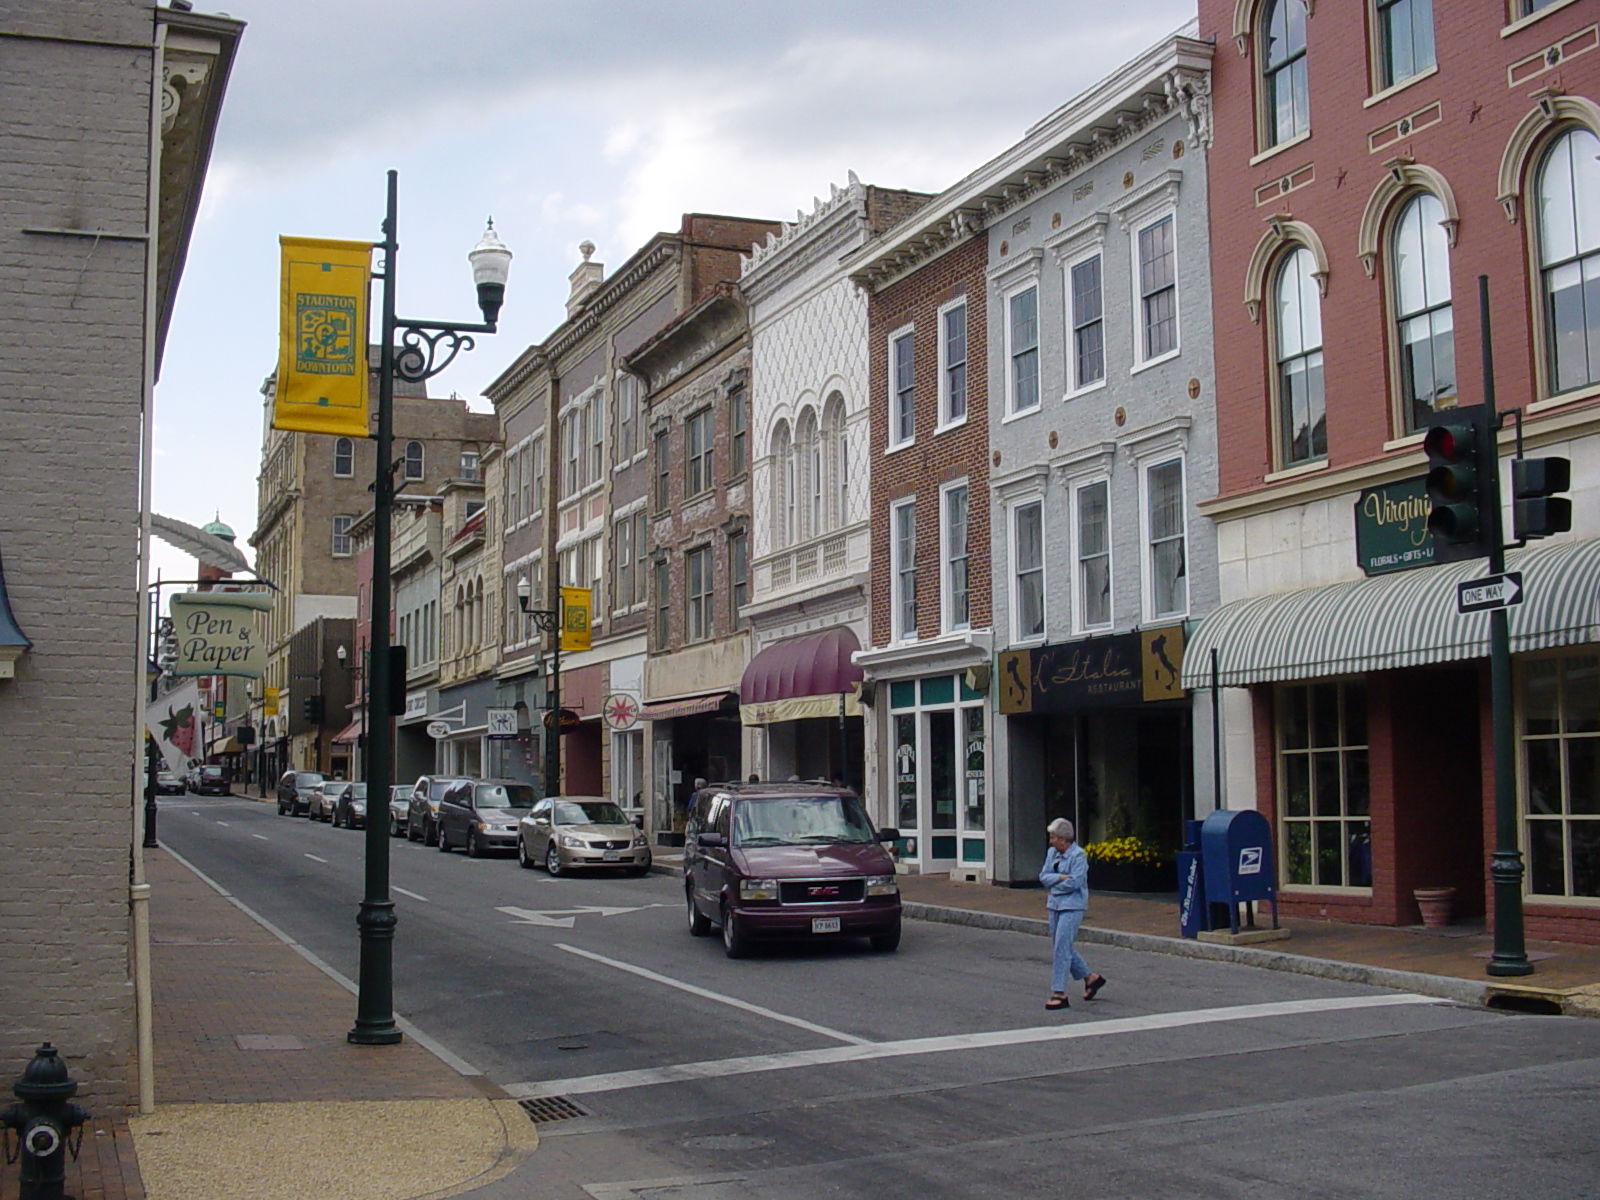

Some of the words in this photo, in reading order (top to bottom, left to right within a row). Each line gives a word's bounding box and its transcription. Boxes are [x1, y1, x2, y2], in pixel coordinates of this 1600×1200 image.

[297, 294, 357, 309] STAUNTON
[296, 359, 355, 375] DOWNTOWN
[1370, 554, 1398, 567] FLORALS
[1403, 549, 1422, 562] GIFTS
[1464, 589, 1483, 604] ONE
[1485, 585, 1505, 599] WAY
[186, 610, 234, 635] Pen
[239, 626, 259, 642] &
[183, 637, 256, 670] Paper
[1087, 679, 1142, 694] RESTAURANT
